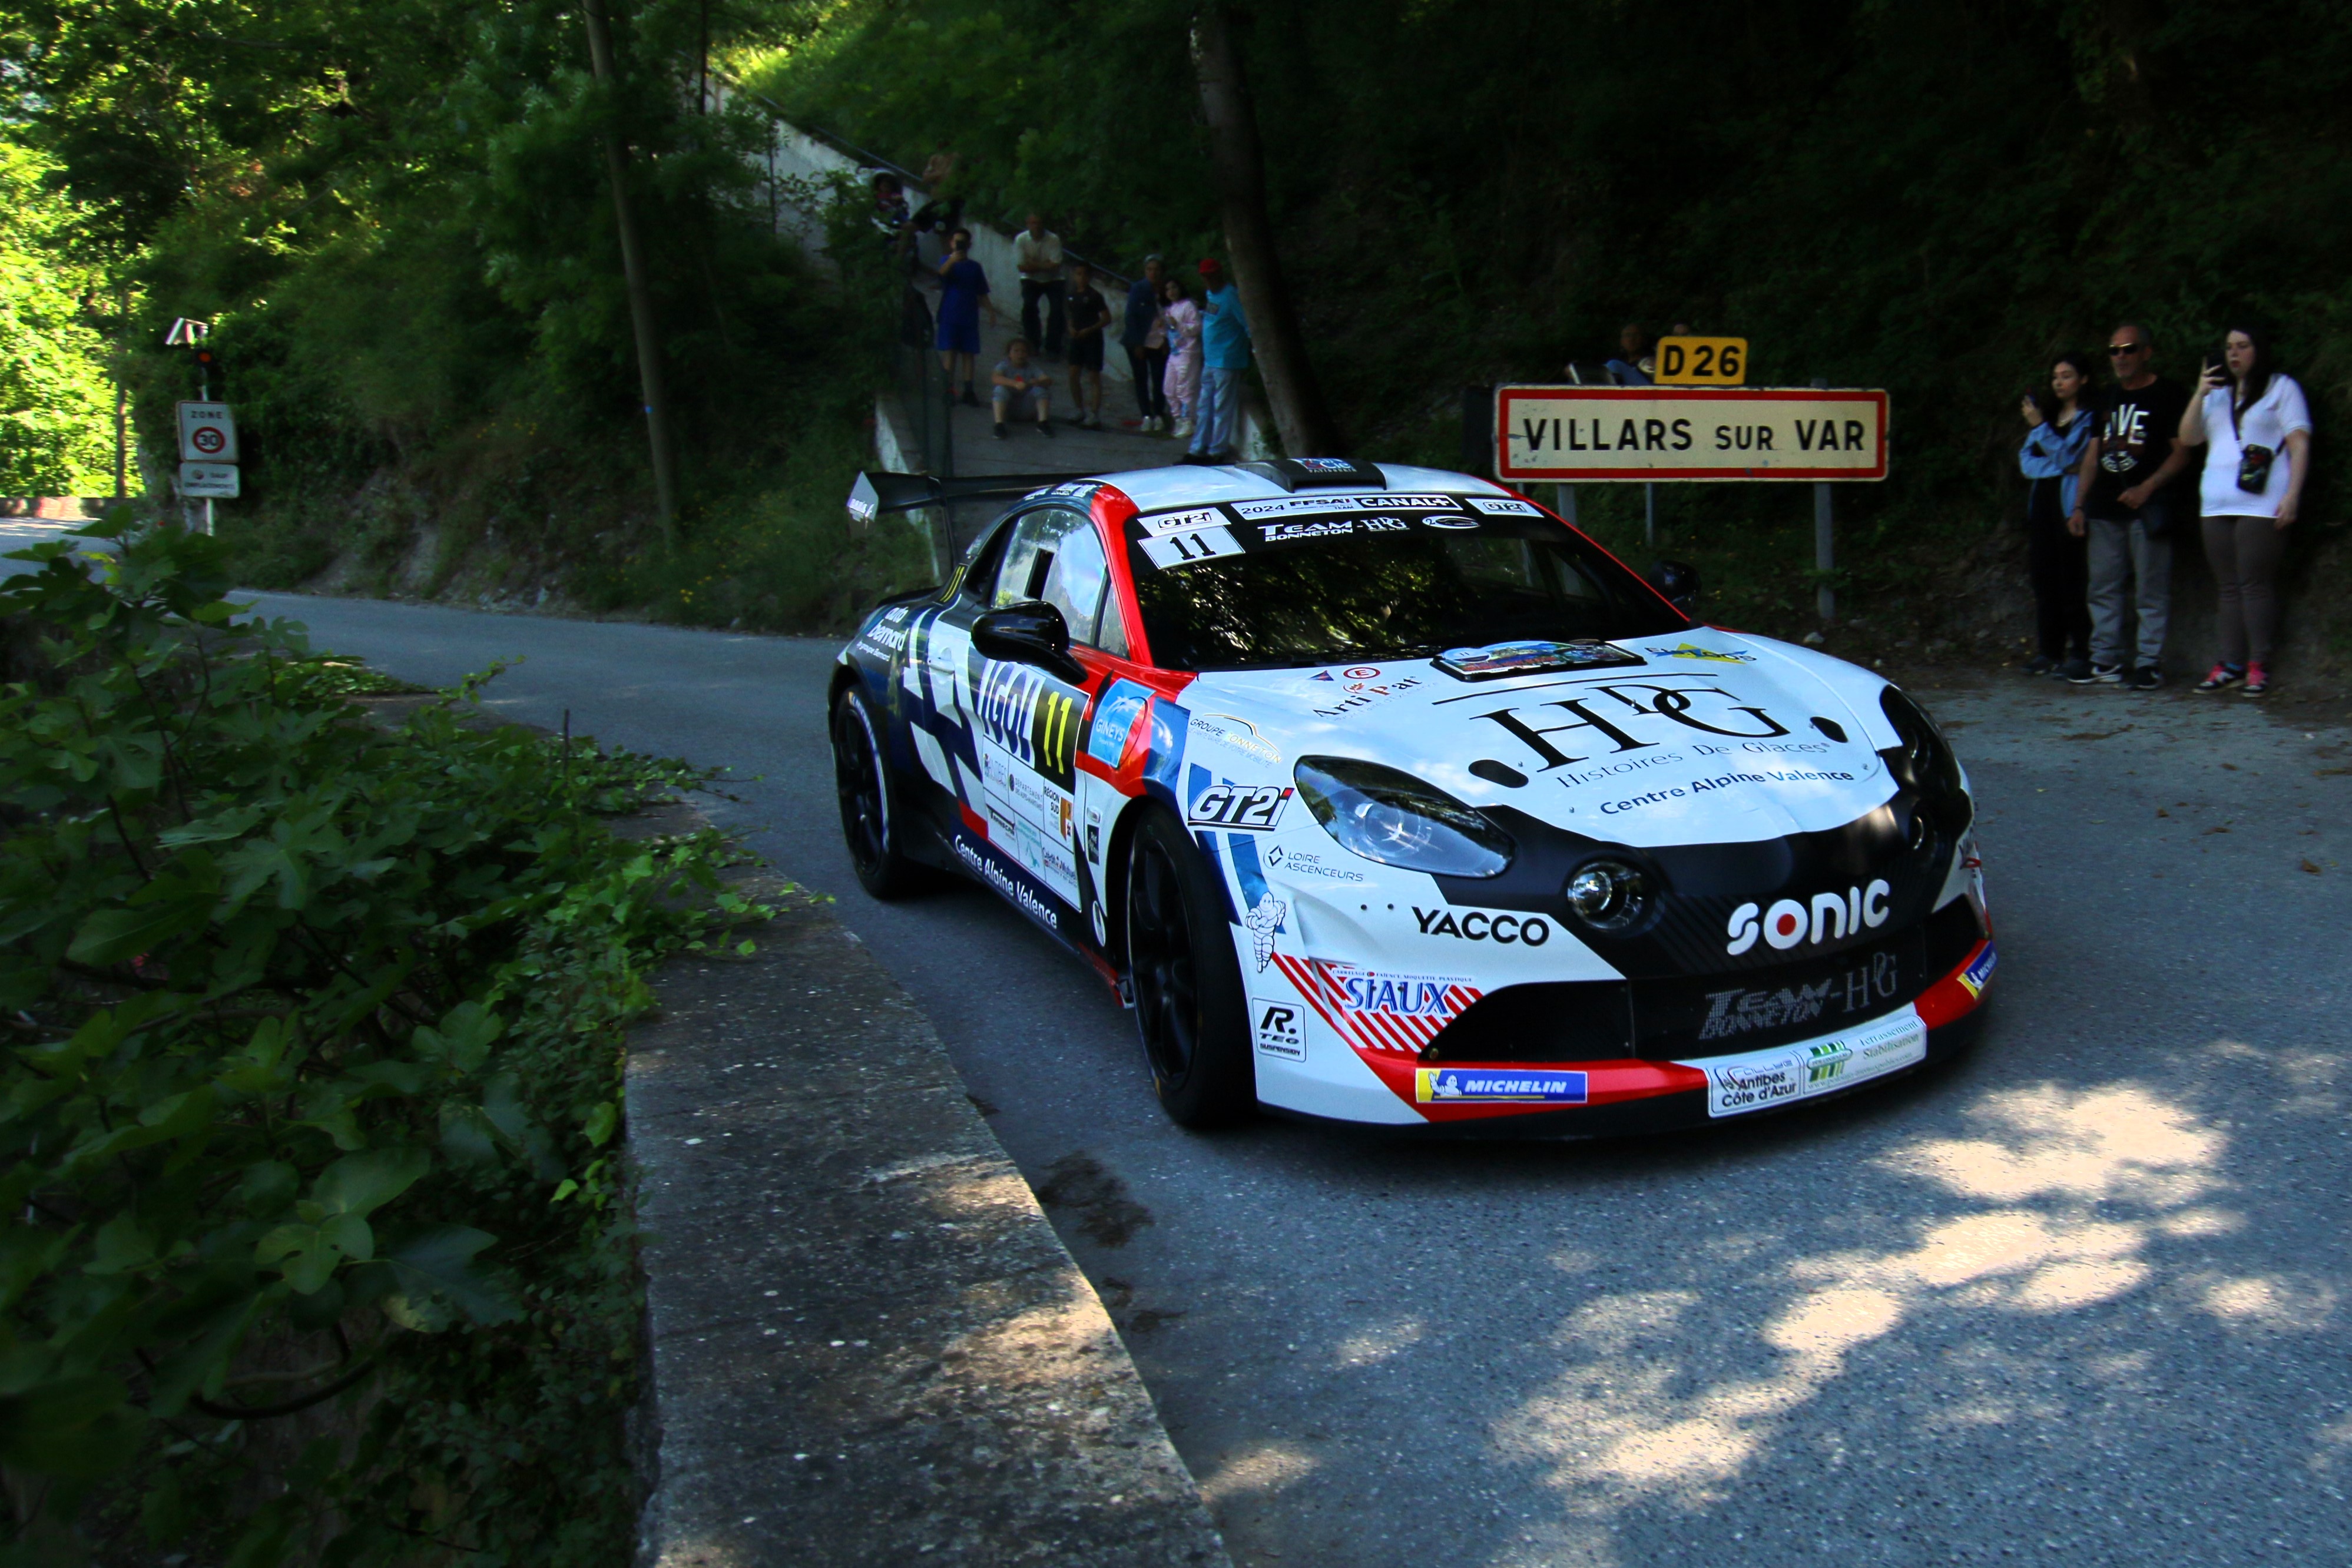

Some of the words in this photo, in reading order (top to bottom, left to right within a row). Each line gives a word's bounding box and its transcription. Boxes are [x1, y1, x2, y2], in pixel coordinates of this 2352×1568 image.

[191, 410, 223, 419] ZONE
[199, 434, 218, 446] 30
[1523, 418, 1694, 451] VILLARS
[1715, 425, 1774, 451] SUR
[1794, 419, 1864, 451] VAR
[1241, 504, 1285, 514] 2024
[1361, 497, 1450, 508] CANAL+
[1158, 511, 1212, 529] GT2i
[1265, 528, 1353, 542] BONNETON
[1170, 533, 1217, 561] 11
[982, 660, 1039, 763] IGOL
[1044, 691, 1073, 775] 11
[1095, 718, 1125, 742] GINEYS
[1190, 718, 1225, 737] GROUPE
[1469, 683, 1791, 773] HPG
[1692, 744, 1732, 755] De
[1600, 787, 1686, 814] Centre
[1691, 772, 1766, 793] Alpine
[1767, 770, 1855, 781] Valence
[1051, 802, 1060, 815] SUD
[1188, 785, 1295, 826] GT2i
[1288, 852, 1321, 864] LOIRE
[955, 834, 983, 871] Centre
[984, 857, 1014, 897] Alpine
[1016, 881, 1058, 930] Valence
[1284, 863, 1364, 882] ASCENCEURS
[1412, 906, 1550, 947] YACCO
[1260, 1043, 1300, 1056] SUSPENSION
[1465, 1080, 1567, 1093] MICHELIN
[1739, 1070, 1786, 1090] Antibes
[1722, 1090, 1755, 1108] Côte
[1758, 1082, 1797, 1100] d'Azur
